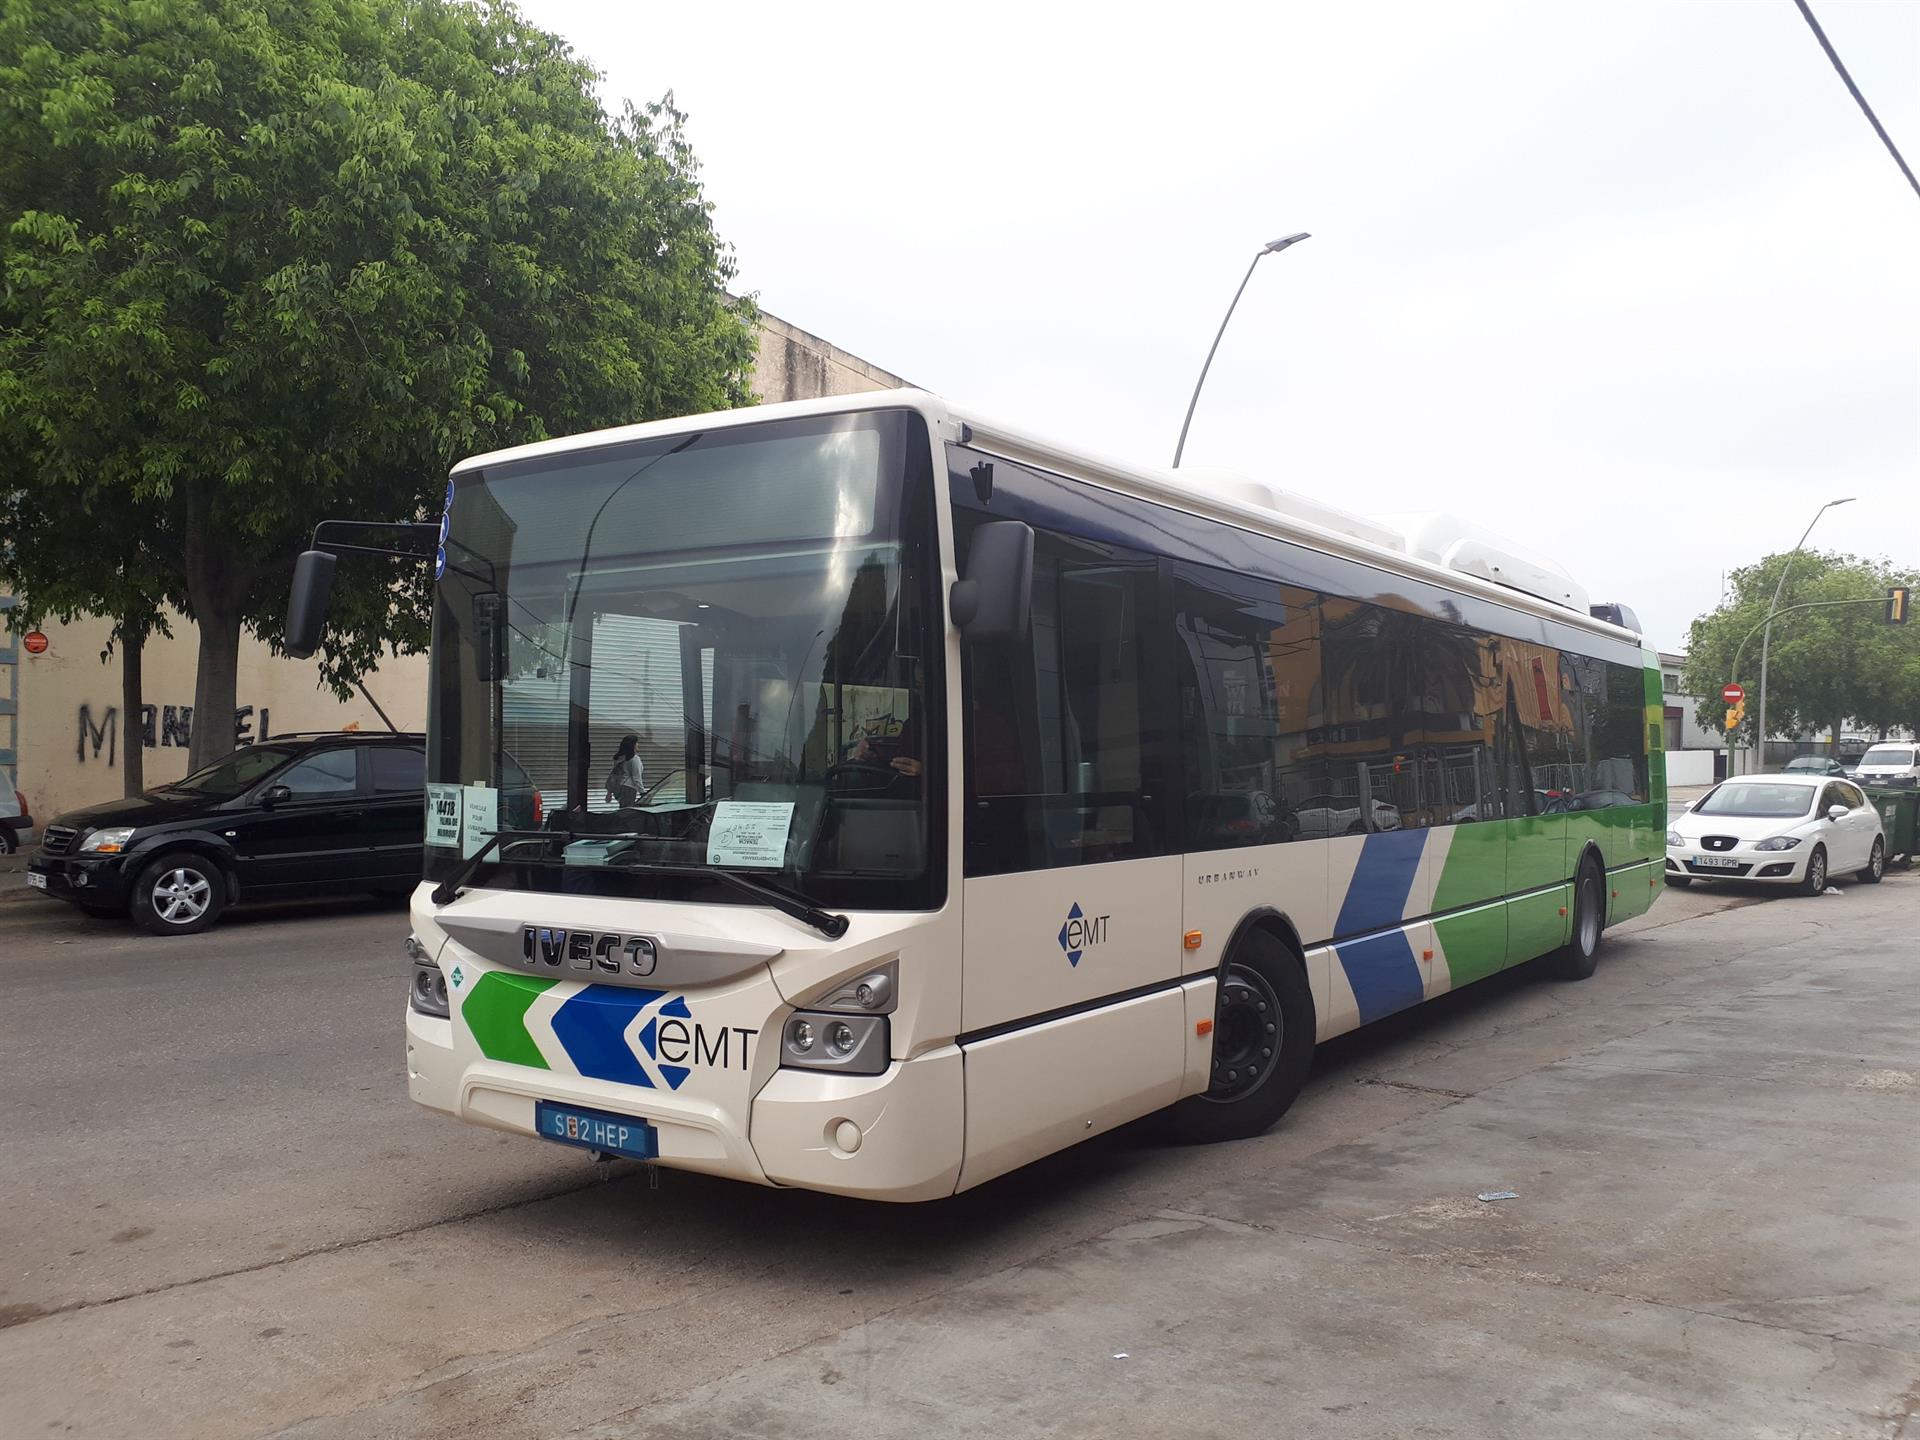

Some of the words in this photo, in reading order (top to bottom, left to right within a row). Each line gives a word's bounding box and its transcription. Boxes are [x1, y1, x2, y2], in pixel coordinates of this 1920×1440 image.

[1700, 858, 1719, 866] 1493
[1721, 859, 1737, 867] GPR
[523, 927, 657, 977] IVECO
[1068, 915, 1111, 949] eMT
[657, 1019, 759, 1070] eMT
